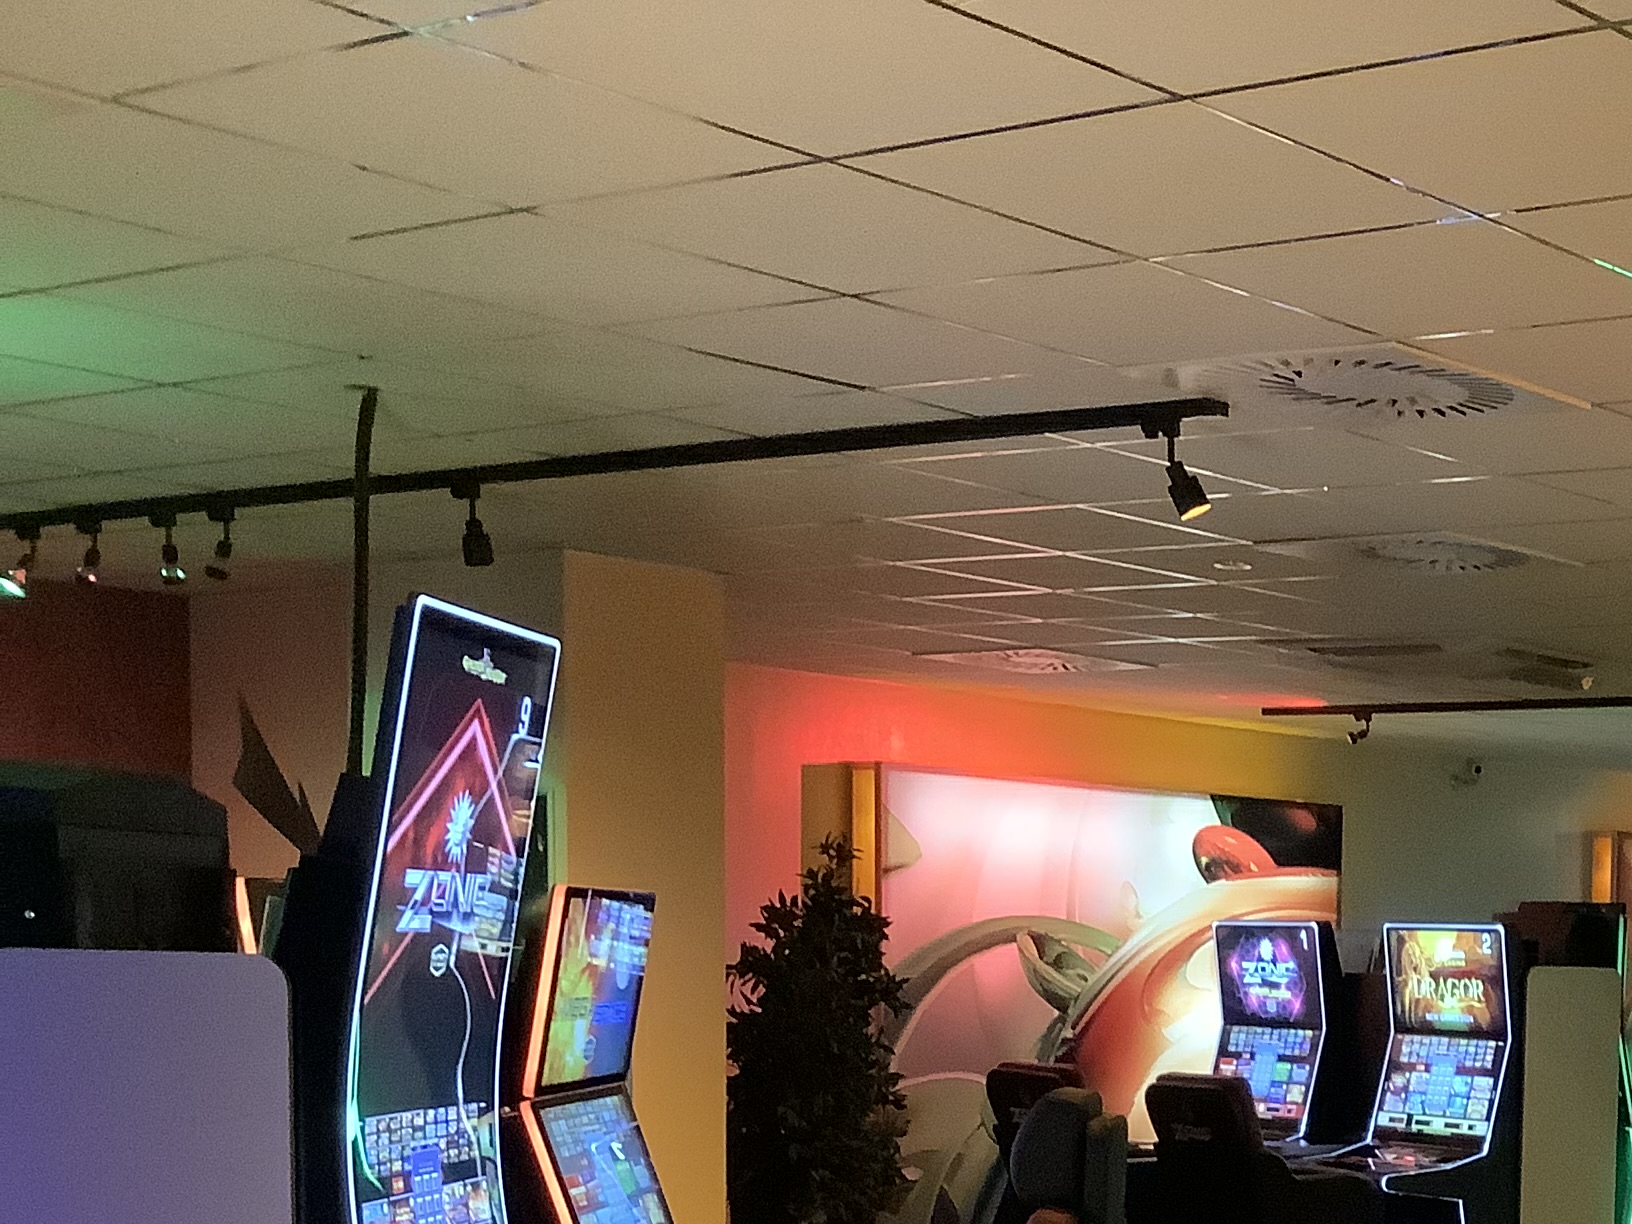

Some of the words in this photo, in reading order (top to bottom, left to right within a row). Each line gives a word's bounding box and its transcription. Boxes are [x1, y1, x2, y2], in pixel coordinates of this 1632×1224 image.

[1299, 928, 1309, 952] 1
[1481, 931, 1493, 955] 2
[1412, 974, 1486, 1002] DRAGOR
